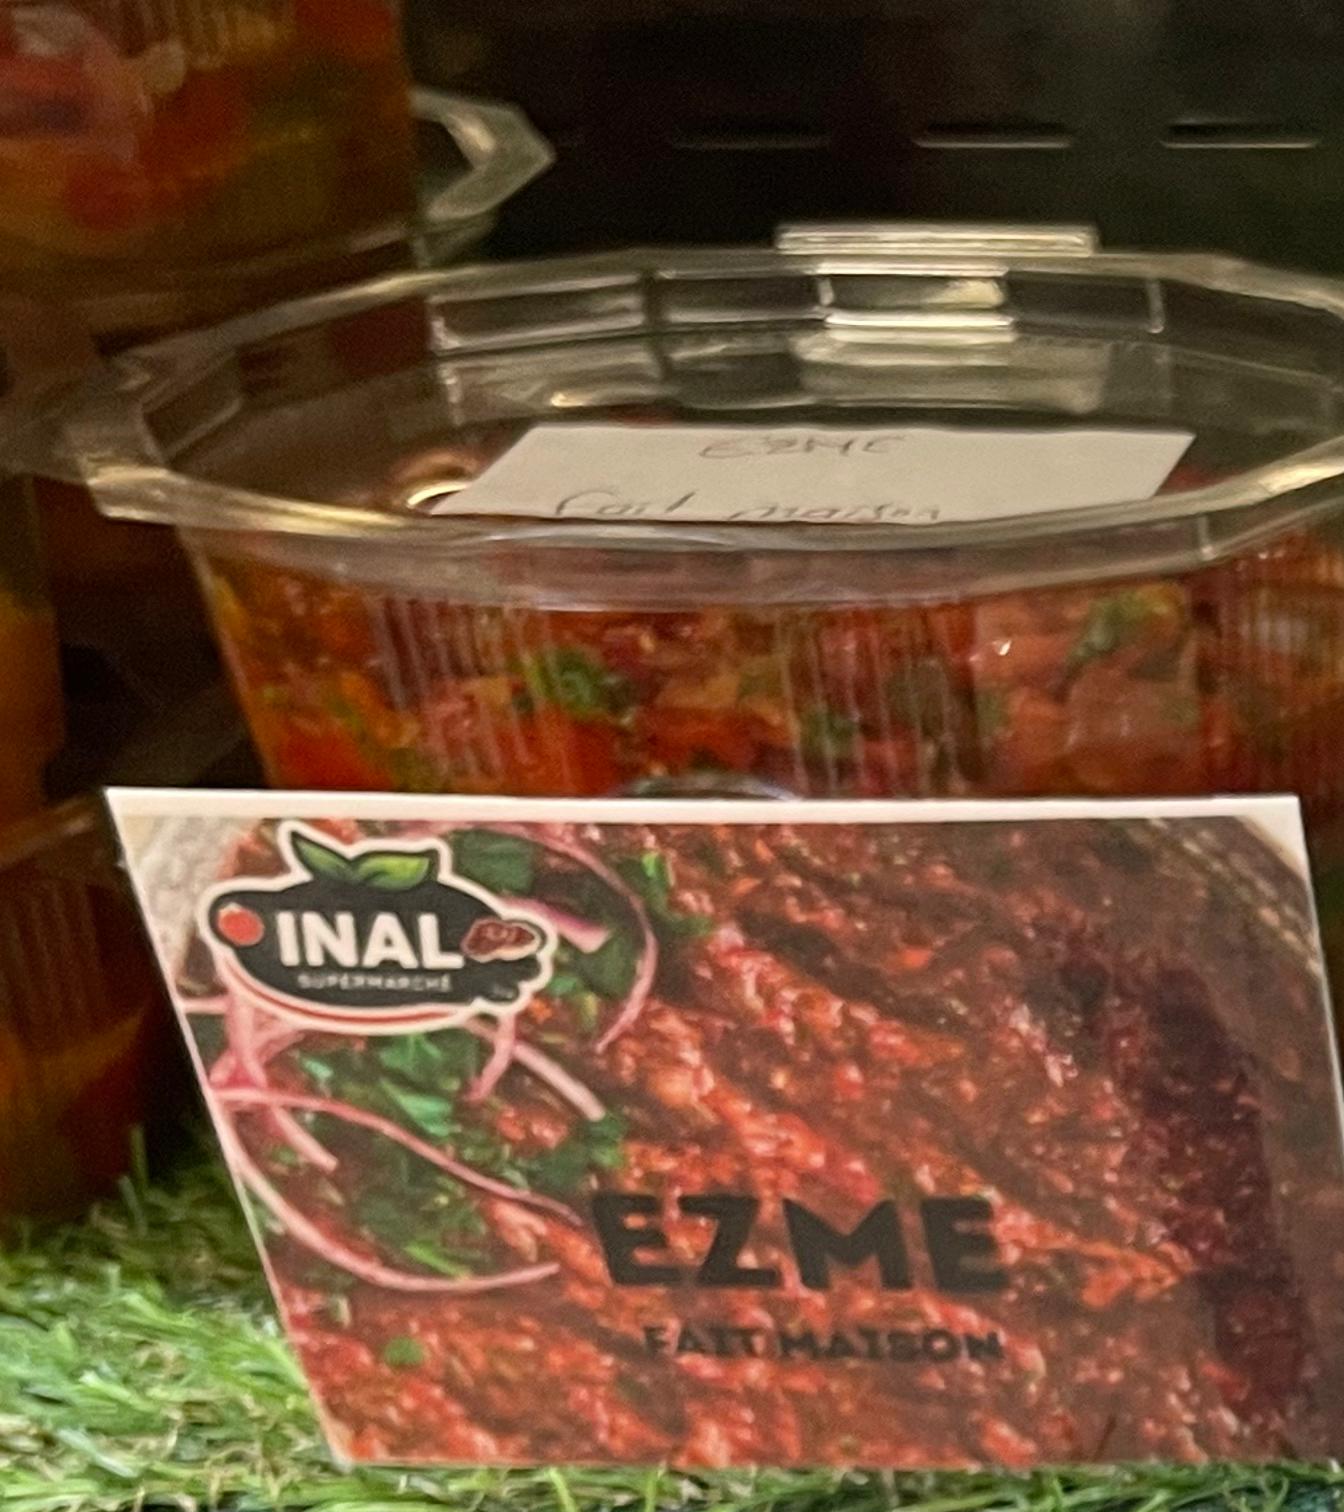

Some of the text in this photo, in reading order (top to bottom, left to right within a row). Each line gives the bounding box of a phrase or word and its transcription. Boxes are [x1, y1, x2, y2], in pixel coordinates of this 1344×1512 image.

[275, 910, 465, 970] INAL
[592, 1193, 1010, 1294] EZME
[643, 1325, 1006, 1363] FAIT MAISON
